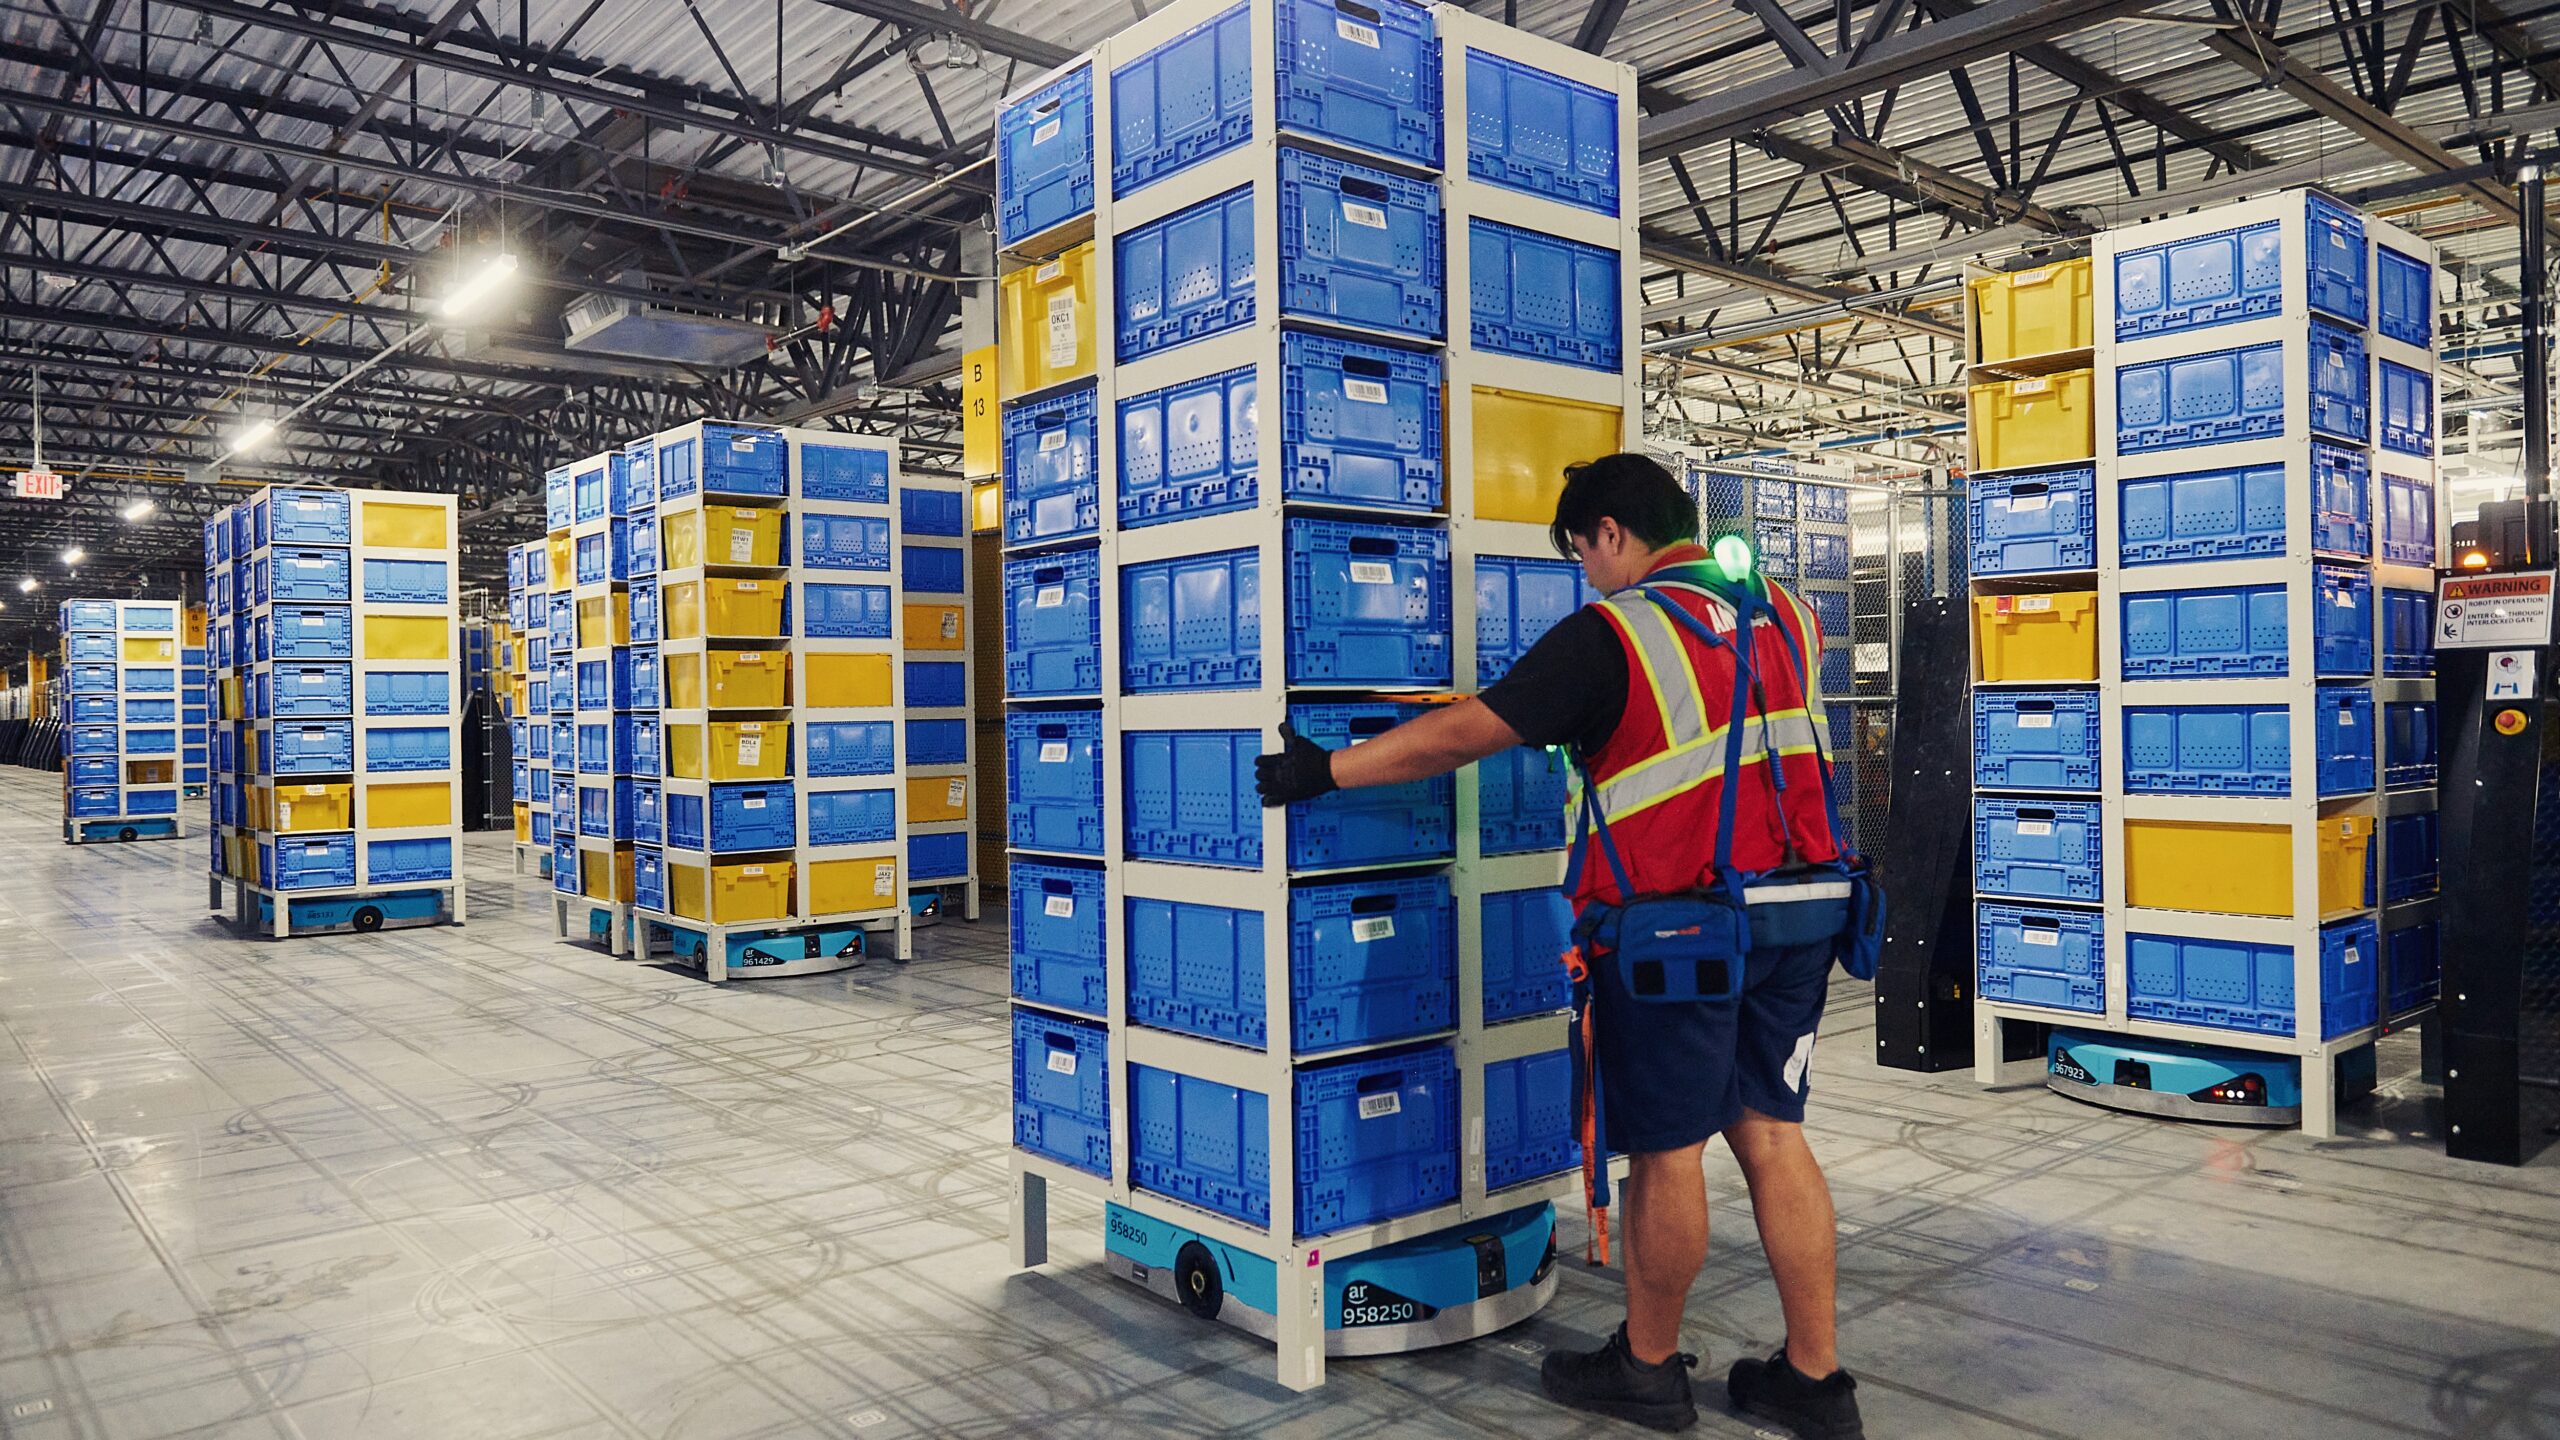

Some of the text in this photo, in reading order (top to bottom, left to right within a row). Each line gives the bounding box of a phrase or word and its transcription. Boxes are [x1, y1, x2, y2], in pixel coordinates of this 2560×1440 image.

[1051, 312, 1070, 325] OKC1
[974, 363, 982, 383] B
[973, 397, 985, 418] 13
[25, 474, 56, 495] EXIT
[2468, 580, 2540, 595] WARNING
[2468, 599, 2491, 607] ROBOT
[2466, 618, 2514, 627] INTERLOCKED
[2467, 612, 2490, 620] ENTER
[2508, 610, 2544, 618] THROUGH
[743, 957, 774, 966] 961429
[2055, 1062, 2085, 1080] 967923
[1110, 1218, 1147, 1247] 958250
[1348, 1284, 1369, 1299] ar
[1343, 1302, 1413, 1325] 958250
